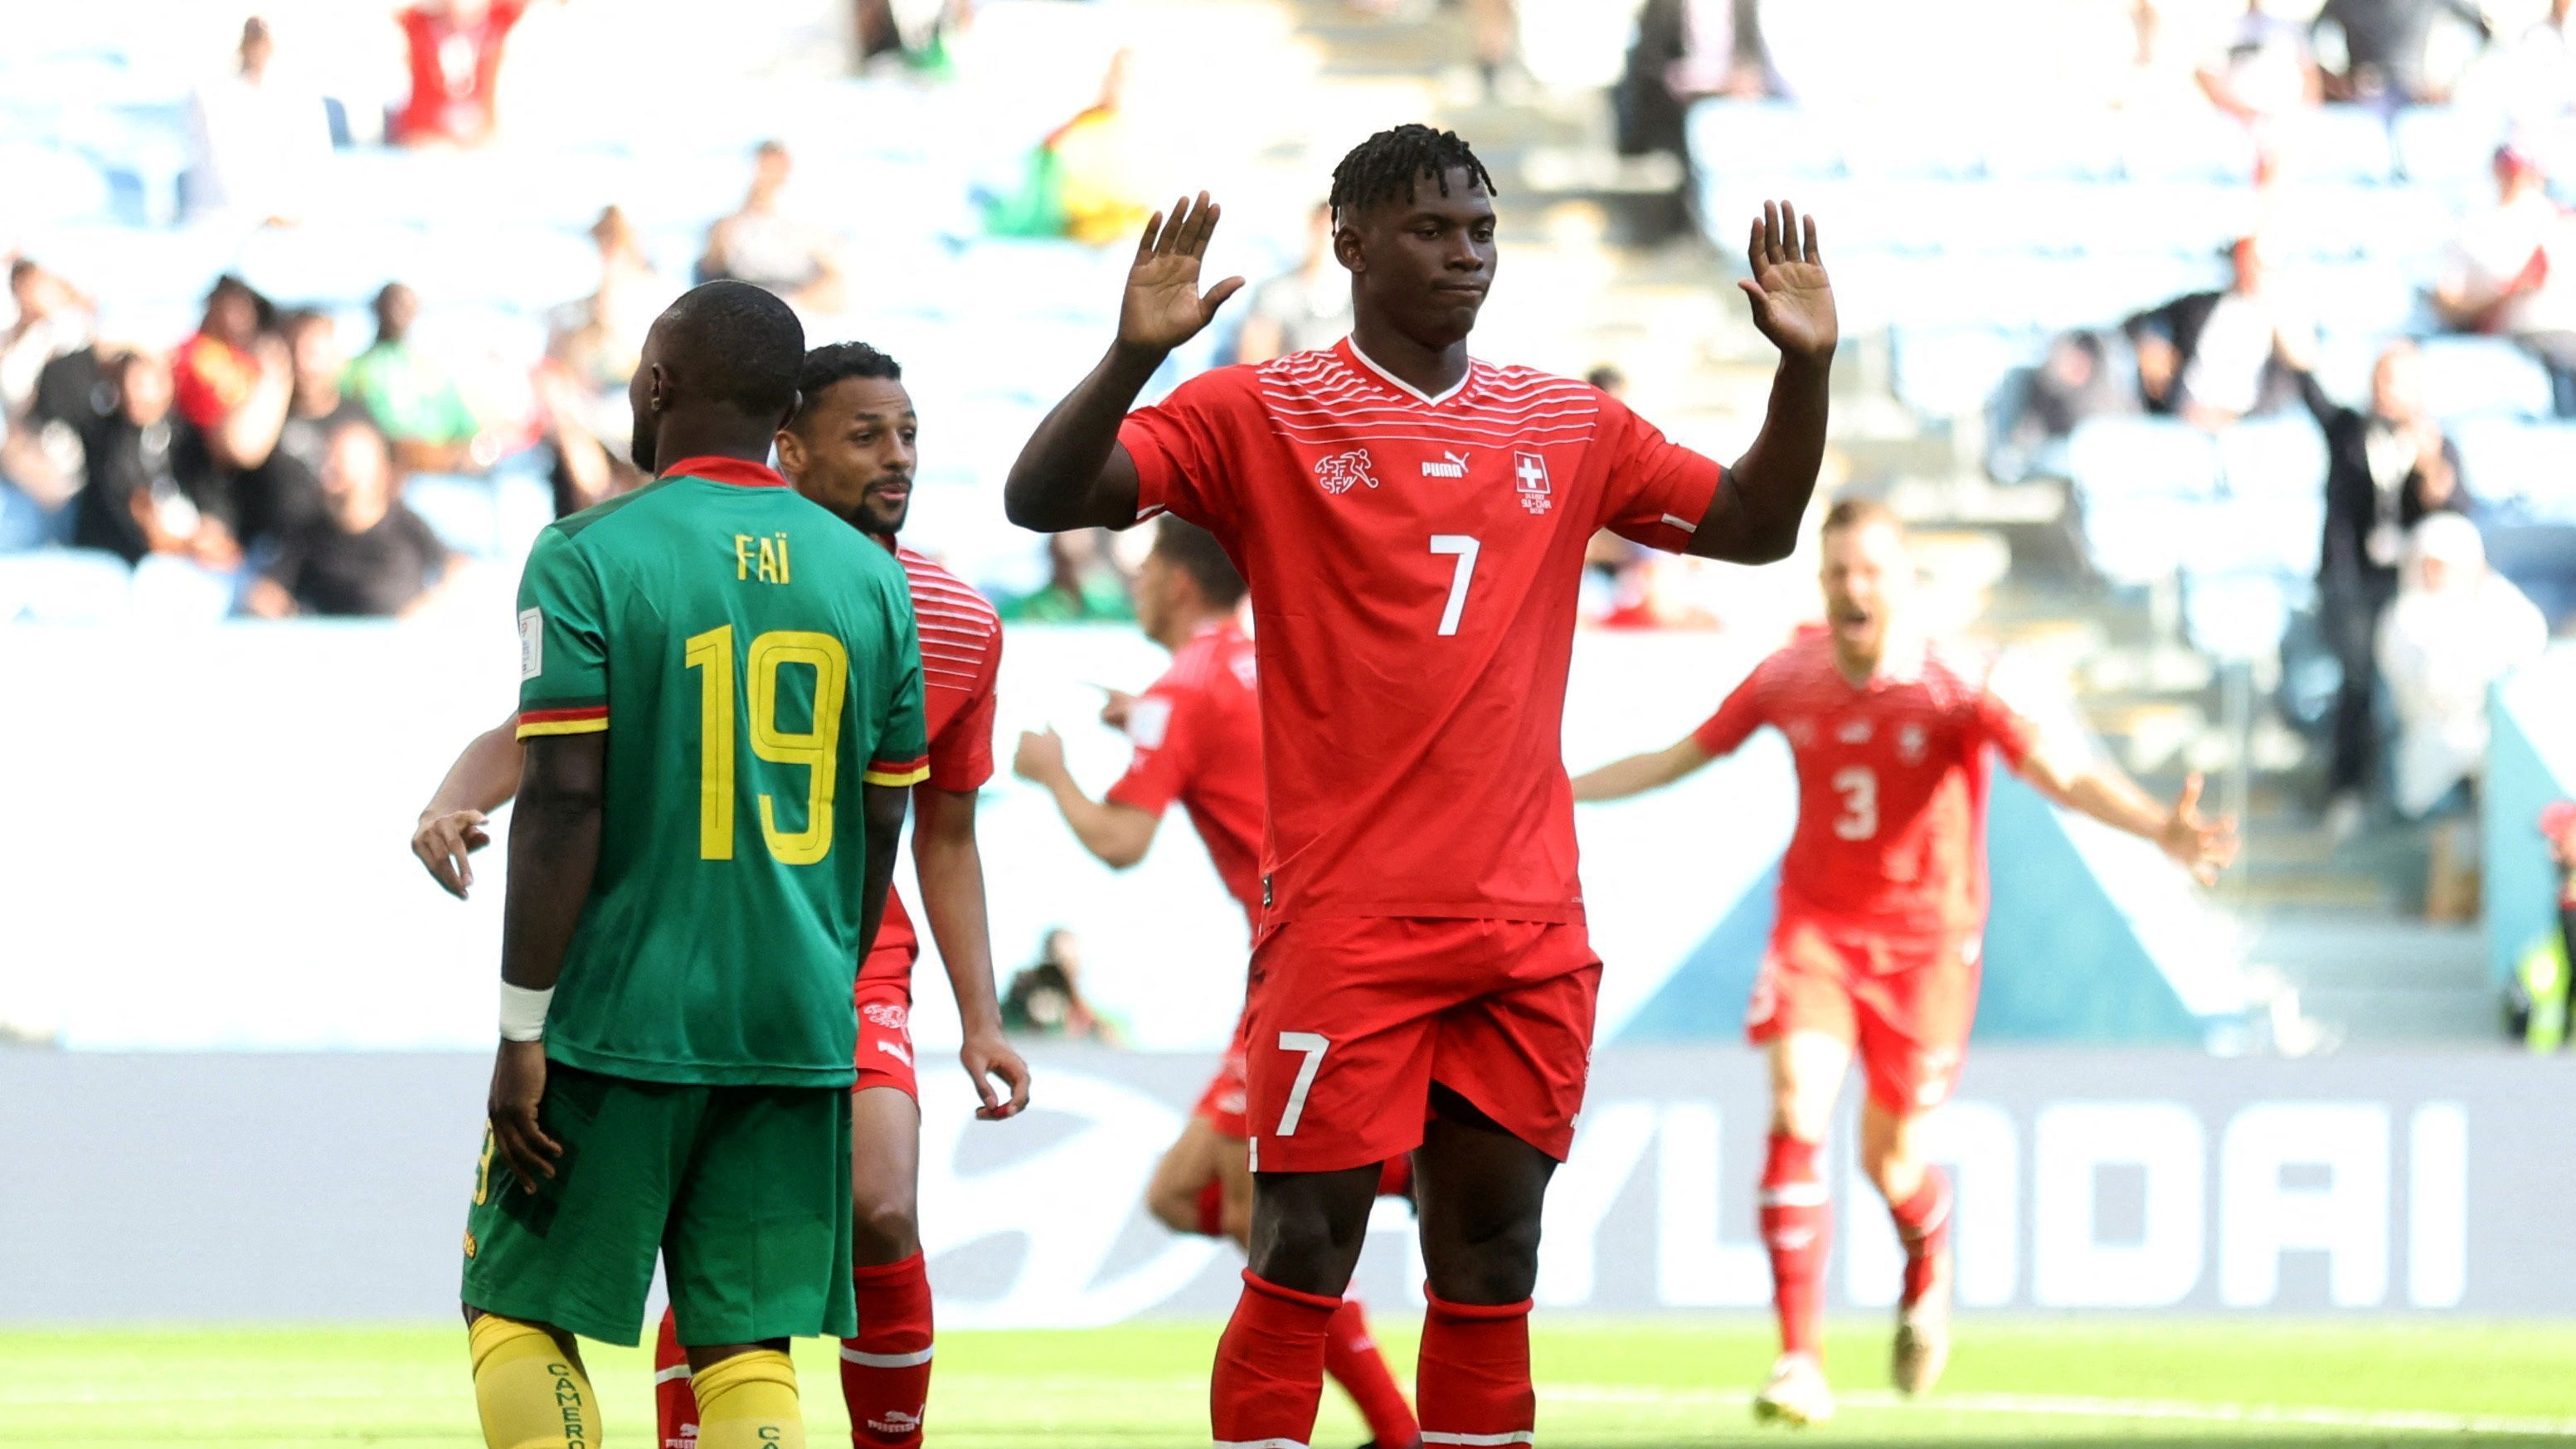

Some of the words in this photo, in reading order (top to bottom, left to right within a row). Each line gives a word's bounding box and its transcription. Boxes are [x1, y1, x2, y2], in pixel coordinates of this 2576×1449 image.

[1422, 461, 1463, 478] PUMA
[734, 532, 790, 585] FAÏ
[1430, 534, 1480, 636] 7
[685, 624, 848, 865] 19
[1831, 764, 1880, 841] 3
[1276, 1031, 1330, 1136] 7
